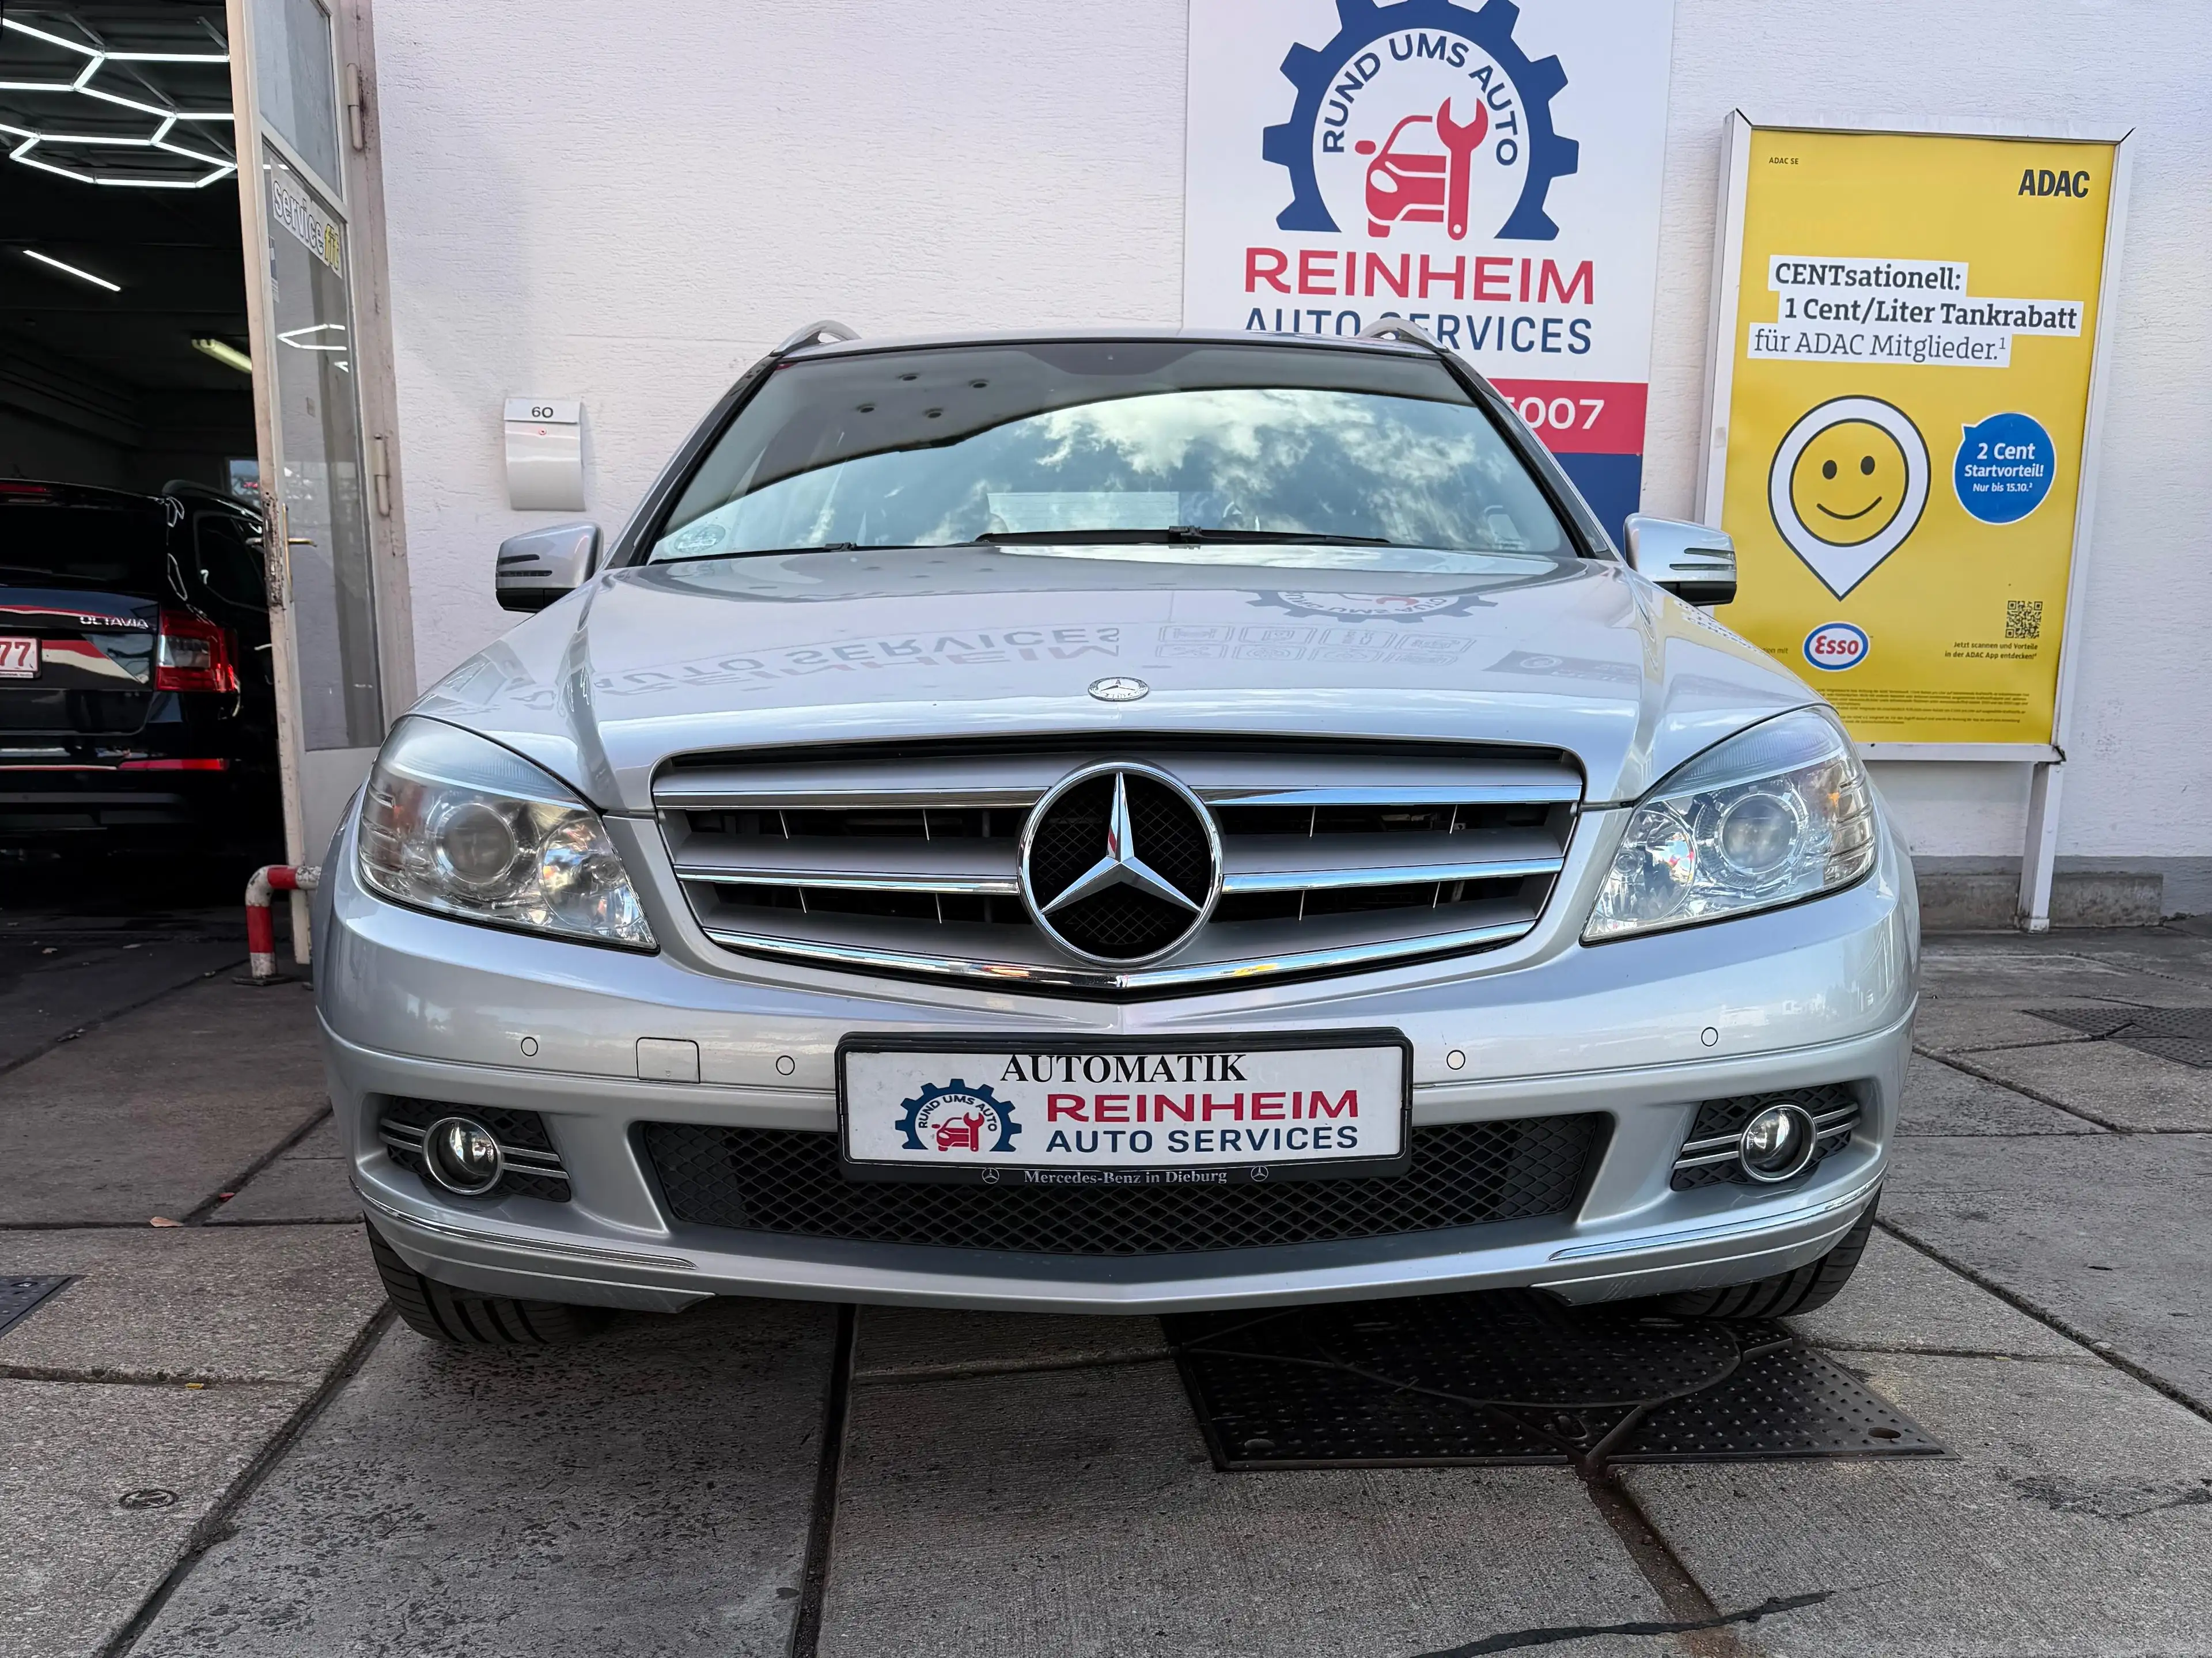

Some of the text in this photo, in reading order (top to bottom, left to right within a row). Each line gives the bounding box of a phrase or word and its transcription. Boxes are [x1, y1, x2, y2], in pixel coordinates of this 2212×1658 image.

[1323, 33, 1518, 166] RUND UMS AUTO
[1768, 157, 1789, 165] ADAC
[2018, 169, 2090, 198] ADAC
[1245, 247, 1594, 305] REINHEIM
[1775, 263, 1961, 290] CENTsationell:
[1785, 297, 2077, 329] 1 Cent/Liter Tankrabatt
[1754, 329, 1790, 352] für
[1794, 332, 1865, 356] ADAC
[531, 406, 554, 418] 60
[1504, 397, 1605, 430] 007
[1977, 442, 2036, 460] 2 Cent
[1964, 462, 2044, 477] Startvorteil!
[1972, 483, 1990, 492] Nur
[1991, 481, 2004, 492] bis
[79, 614, 149, 630] OCTAVIA
[1815, 635, 1859, 655] Esso
[999, 1054, 1248, 1083] AUTOMATIK
[918, 1095, 998, 1132] RUND UMS AUTO
[1047, 1090, 1358, 1122] REINHEIM
[1046, 1125, 1358, 1153] AUTO SERVICES
[1024, 1170, 1228, 1185] Mercedes-Benz in Dieburg
